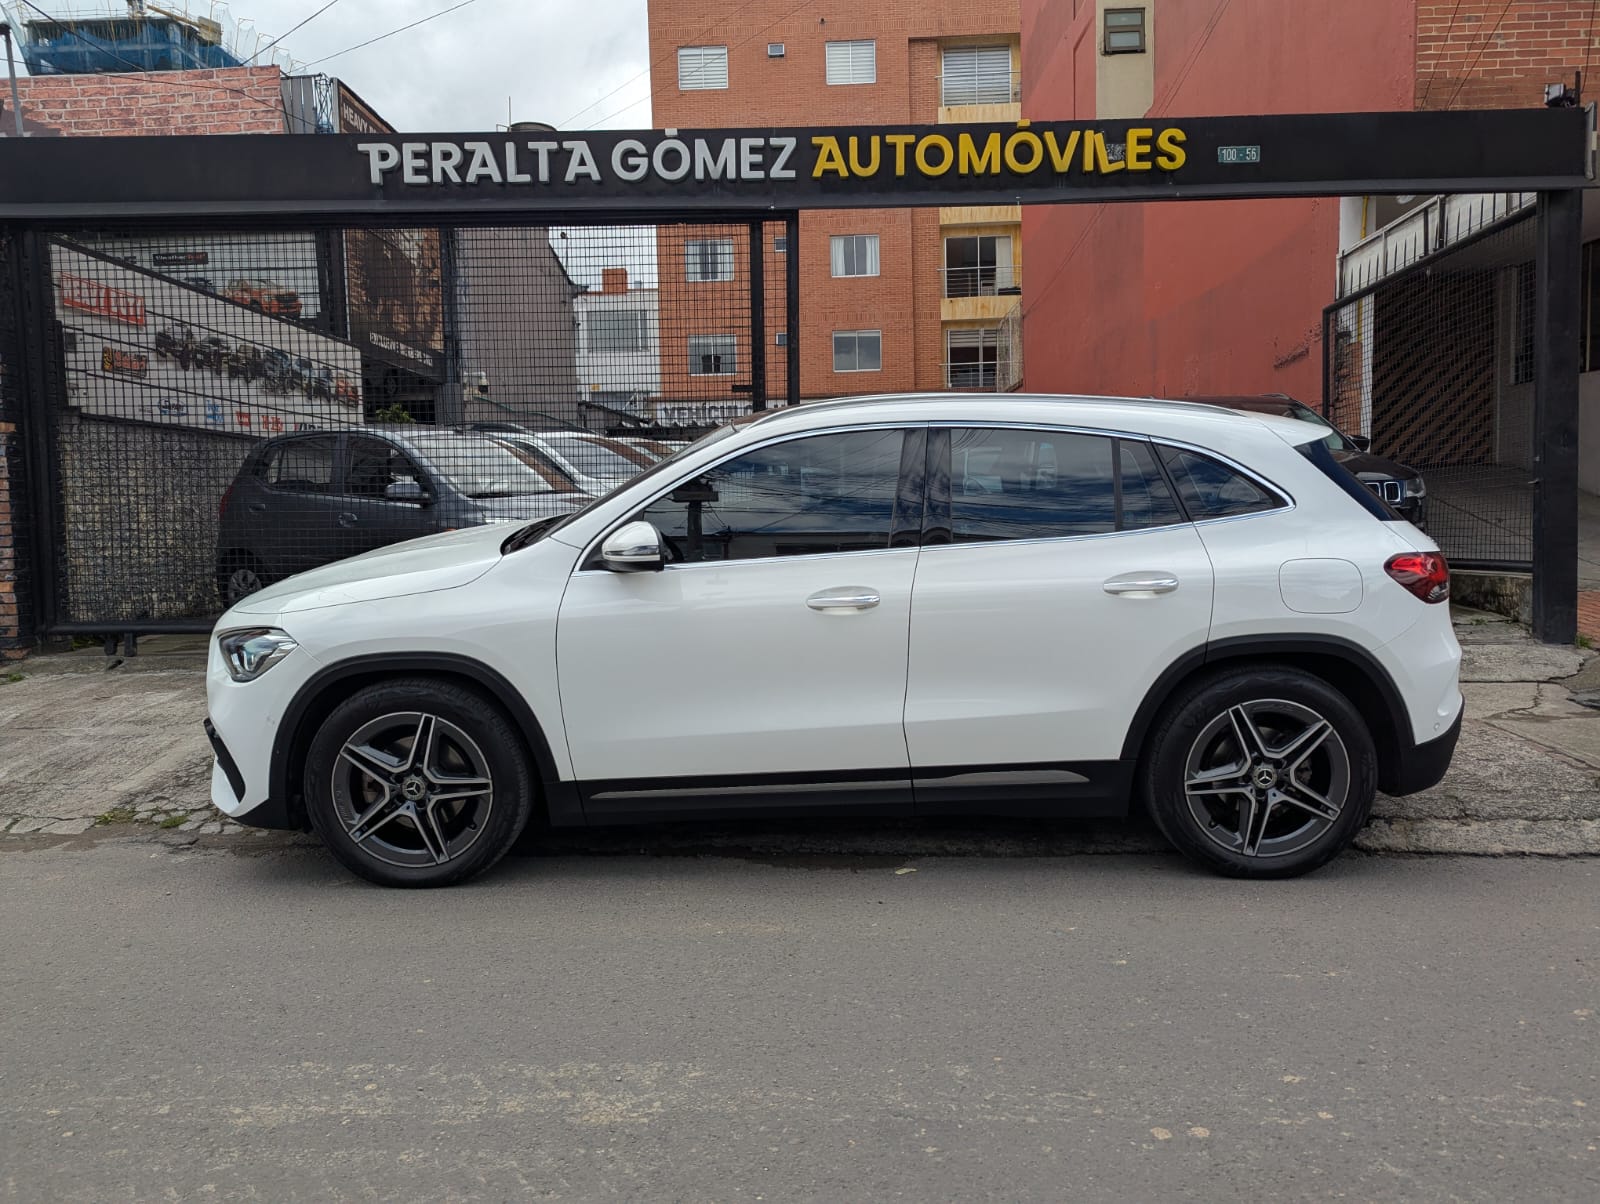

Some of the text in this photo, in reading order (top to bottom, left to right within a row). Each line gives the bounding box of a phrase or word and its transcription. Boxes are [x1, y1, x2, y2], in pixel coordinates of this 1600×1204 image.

[343, 102, 367, 134] HEAVY
[357, 119, 1188, 186] PERALTA GÓMEZ AUTOMÓVILES
[1222, 148, 1237, 160] 100
[1246, 148, 1256, 160] 56
